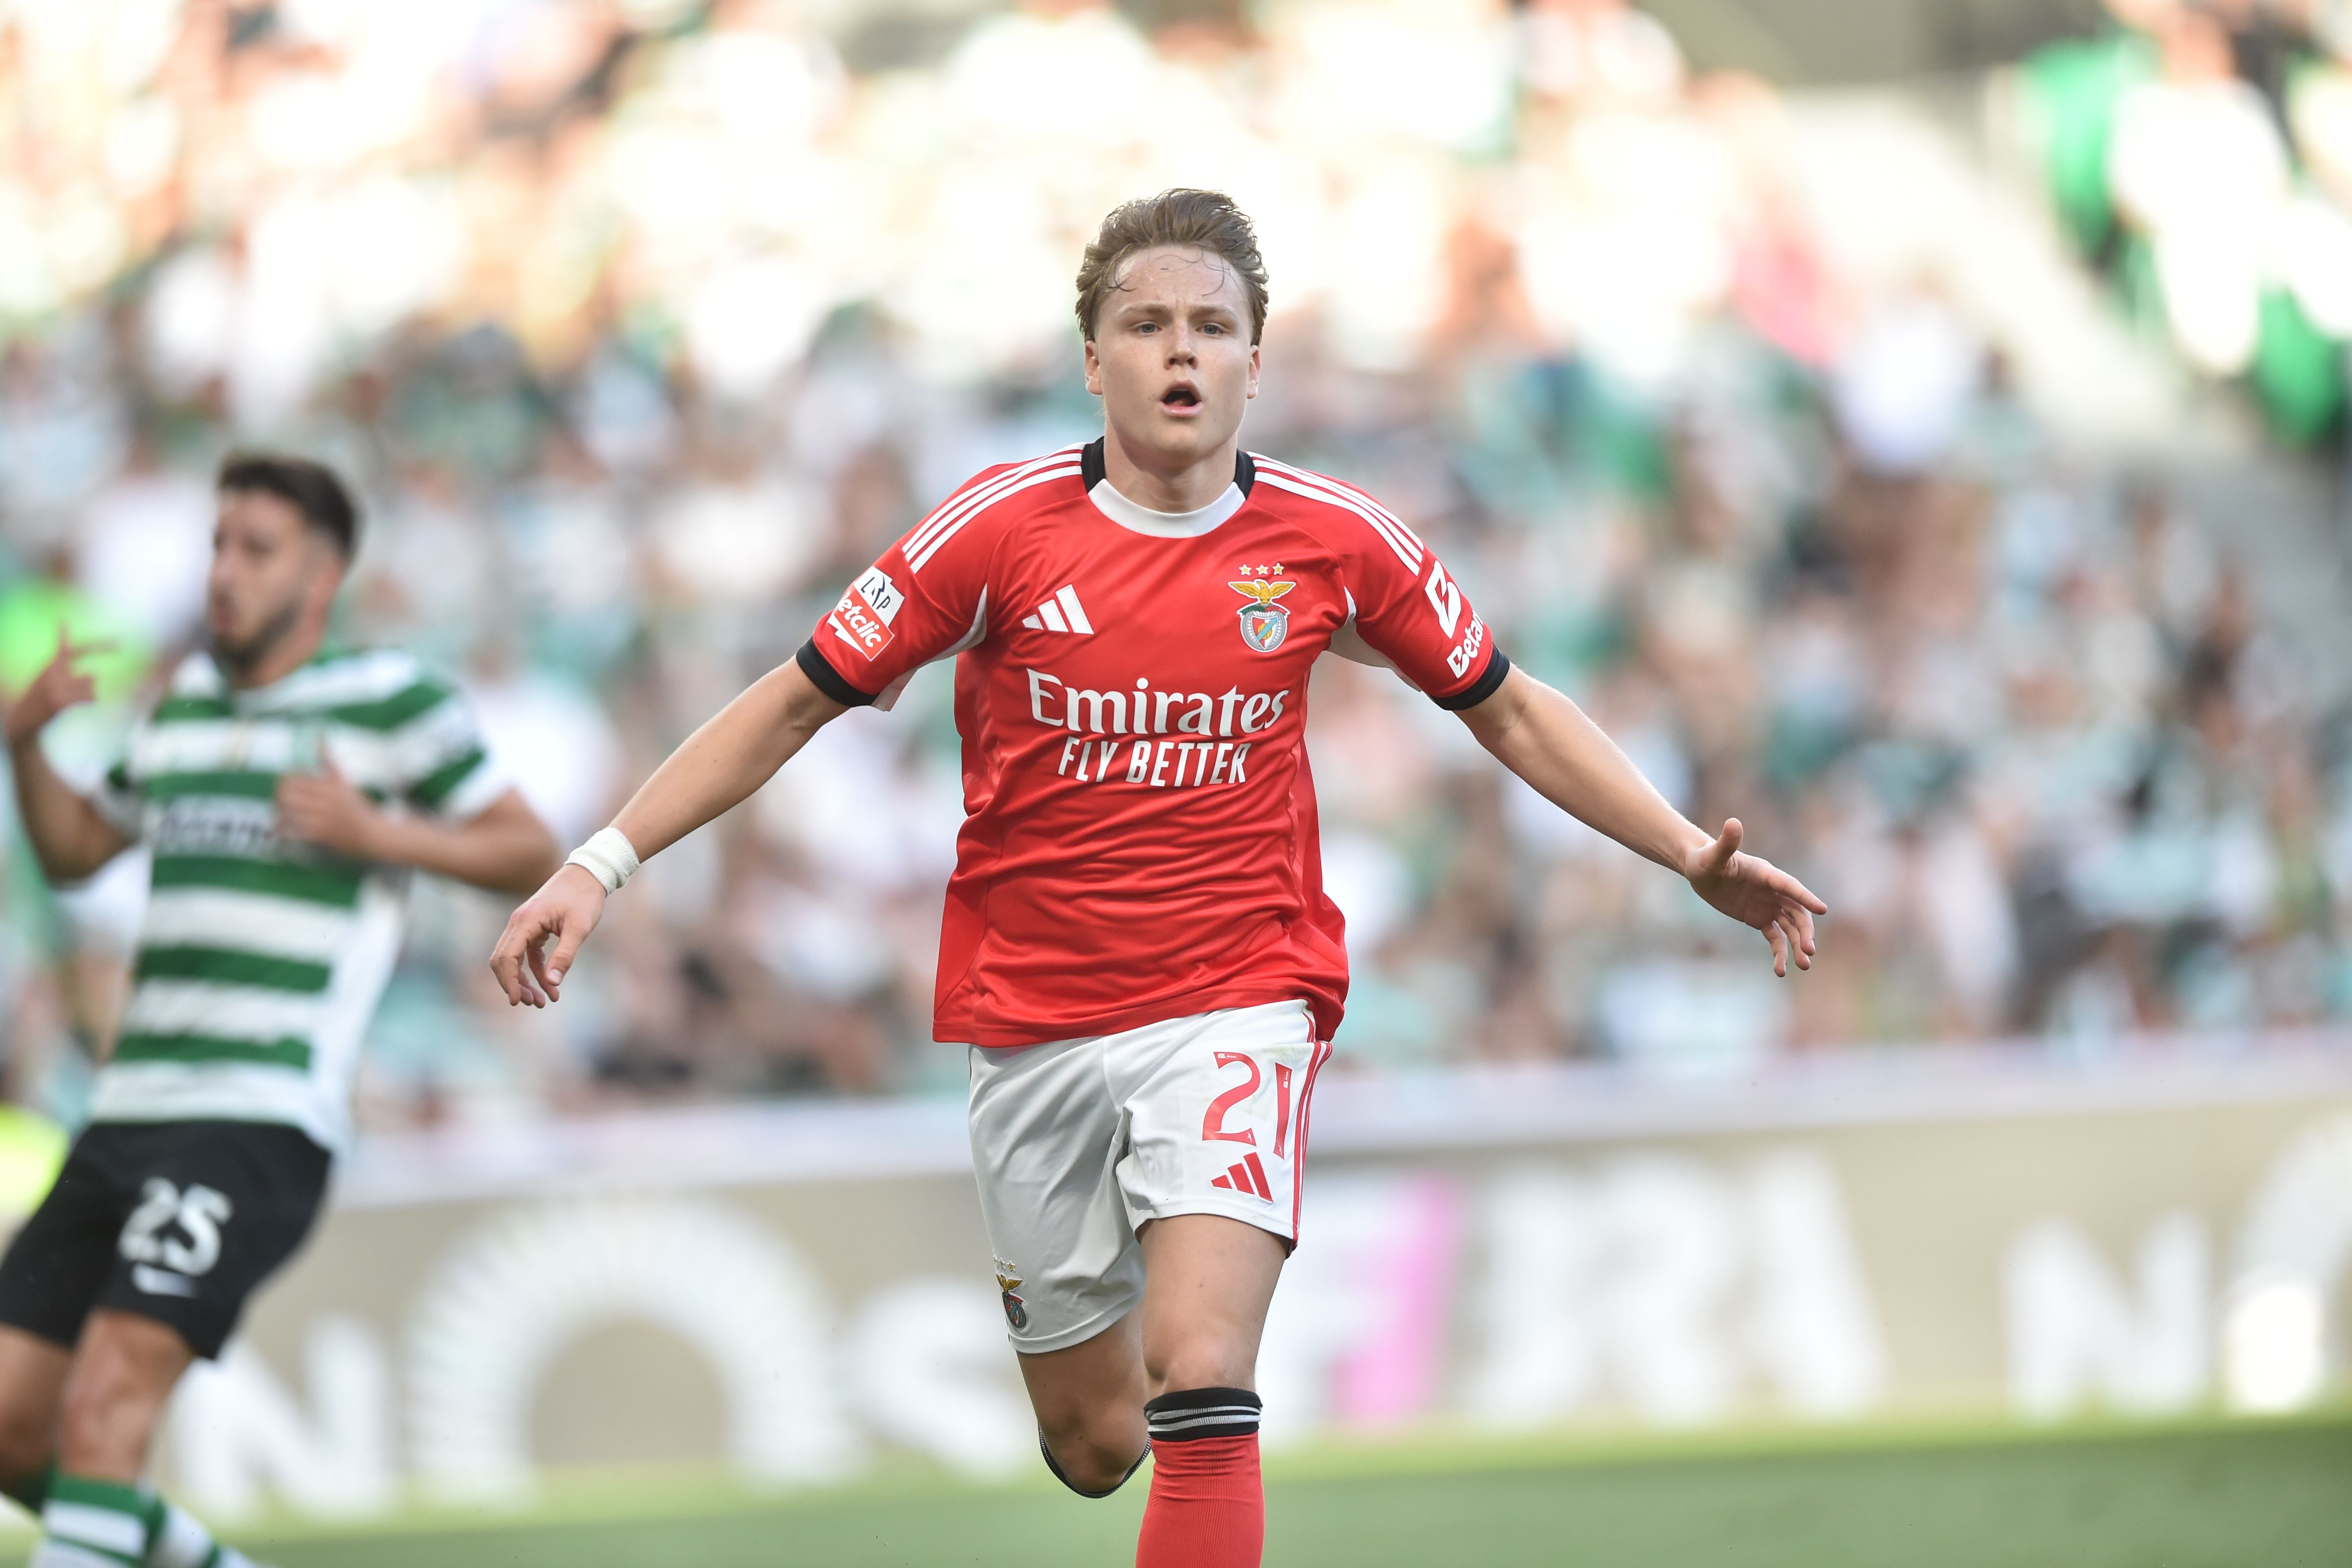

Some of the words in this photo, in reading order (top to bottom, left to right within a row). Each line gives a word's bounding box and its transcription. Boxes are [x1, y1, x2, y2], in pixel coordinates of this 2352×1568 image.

[837, 591, 882, 648] etclic
[1446, 609, 1484, 679] Betan
[1026, 667, 1289, 737] Emirates
[1057, 735, 1119, 783] FLY
[1125, 740, 1252, 787] BETTER
[1202, 1051, 1293, 1161] 21
[119, 1176, 233, 1277] 25
